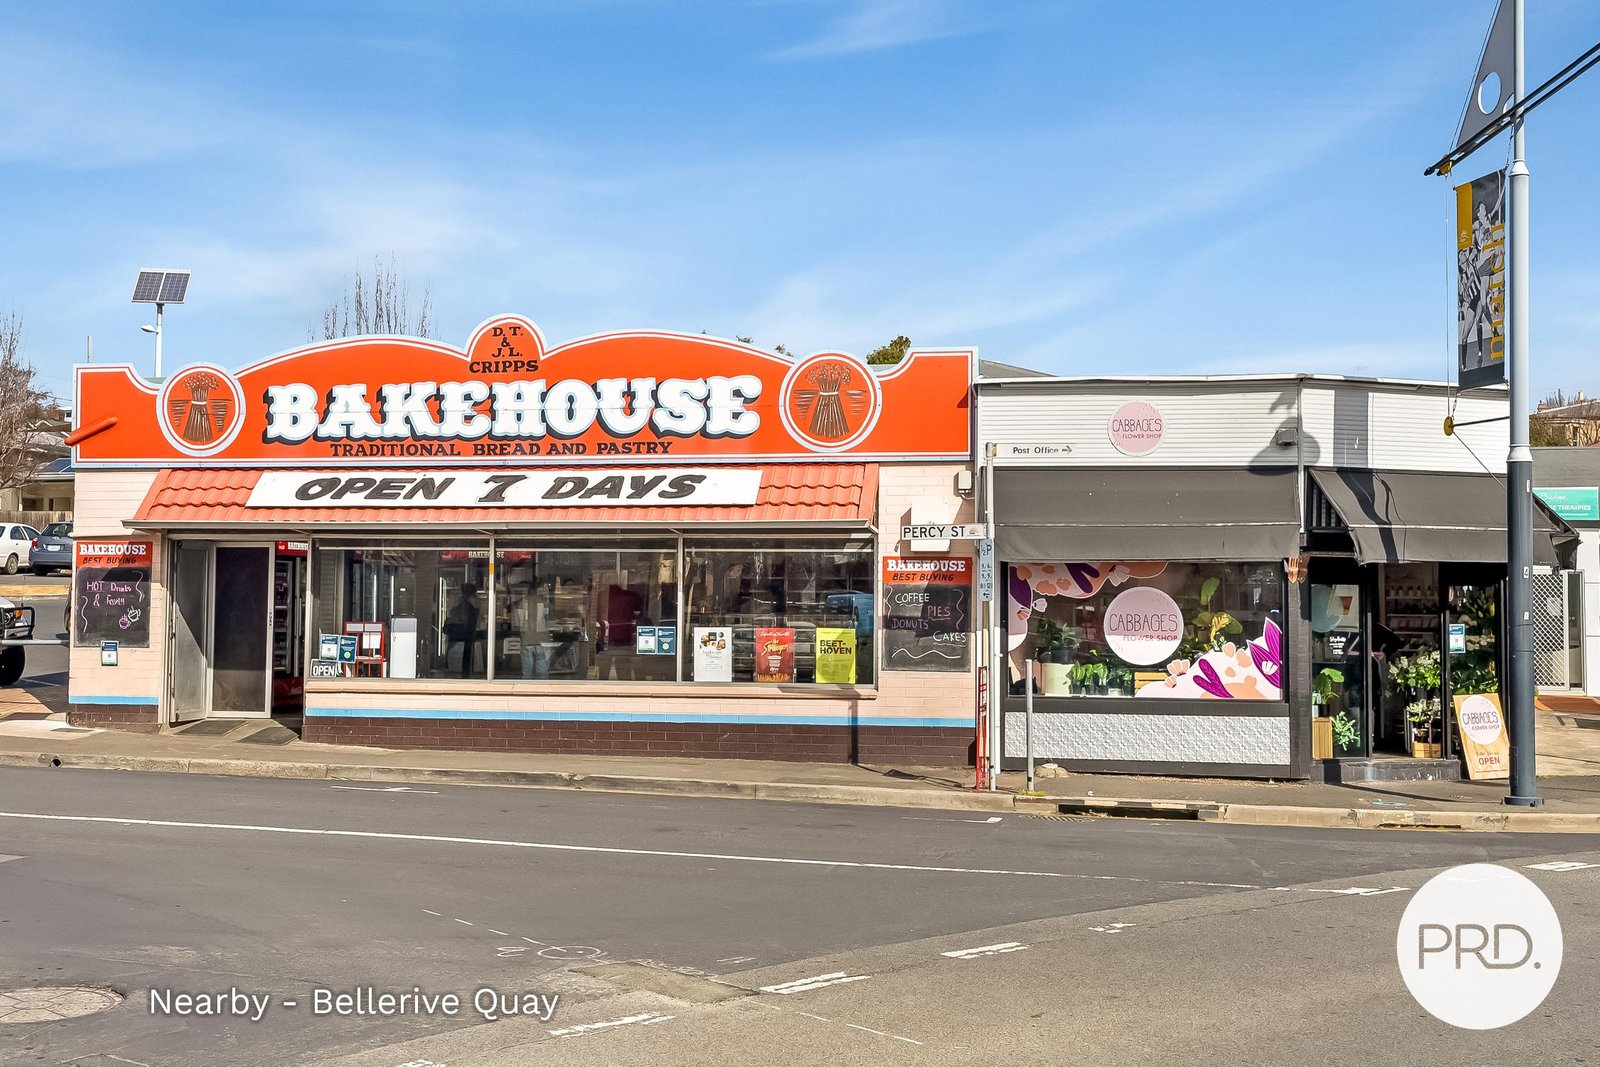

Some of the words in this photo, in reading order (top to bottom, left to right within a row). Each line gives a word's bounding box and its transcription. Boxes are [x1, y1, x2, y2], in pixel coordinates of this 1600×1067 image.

[501, 336, 511, 347] &
[468, 360, 539, 373] CRIPPS
[262, 374, 763, 445] BAKEHOUSE
[1112, 418, 1162, 432] CABBAGES
[330, 443, 461, 457] TRADITIONAL
[473, 443, 541, 456] BREAD
[546, 442, 587, 455] AND
[596, 441, 673, 455] PASTRY
[1013, 446, 1030, 454] Post
[1034, 446, 1059, 454] Office
[295, 477, 456, 501] OPEN
[476, 474, 531, 503] 7
[541, 474, 707, 500] DAYS
[903, 526, 945, 538] PERCY
[951, 526, 965, 537] ST
[79, 544, 147, 555] BAKEHOUSE
[82, 556, 103, 564] BEST
[106, 556, 137, 564] BUYING
[886, 559, 966, 572] BAKEHOUSE
[892, 573, 915, 581] BEST
[919, 573, 955, 581] BUYING
[86, 581, 104, 591] HOT
[895, 593, 930, 604] COFFEE
[927, 605, 951, 617] PIES
[892, 617, 929, 630] DONUTS
[1109, 613, 1178, 632] CABBAGES
[933, 631, 966, 643] CAKES
[820, 647, 852, 655] HOVEN
[312, 665, 335, 676] OPEN
[1462, 711, 1499, 725] CABBAGES
[1479, 757, 1501, 766] OPEN
